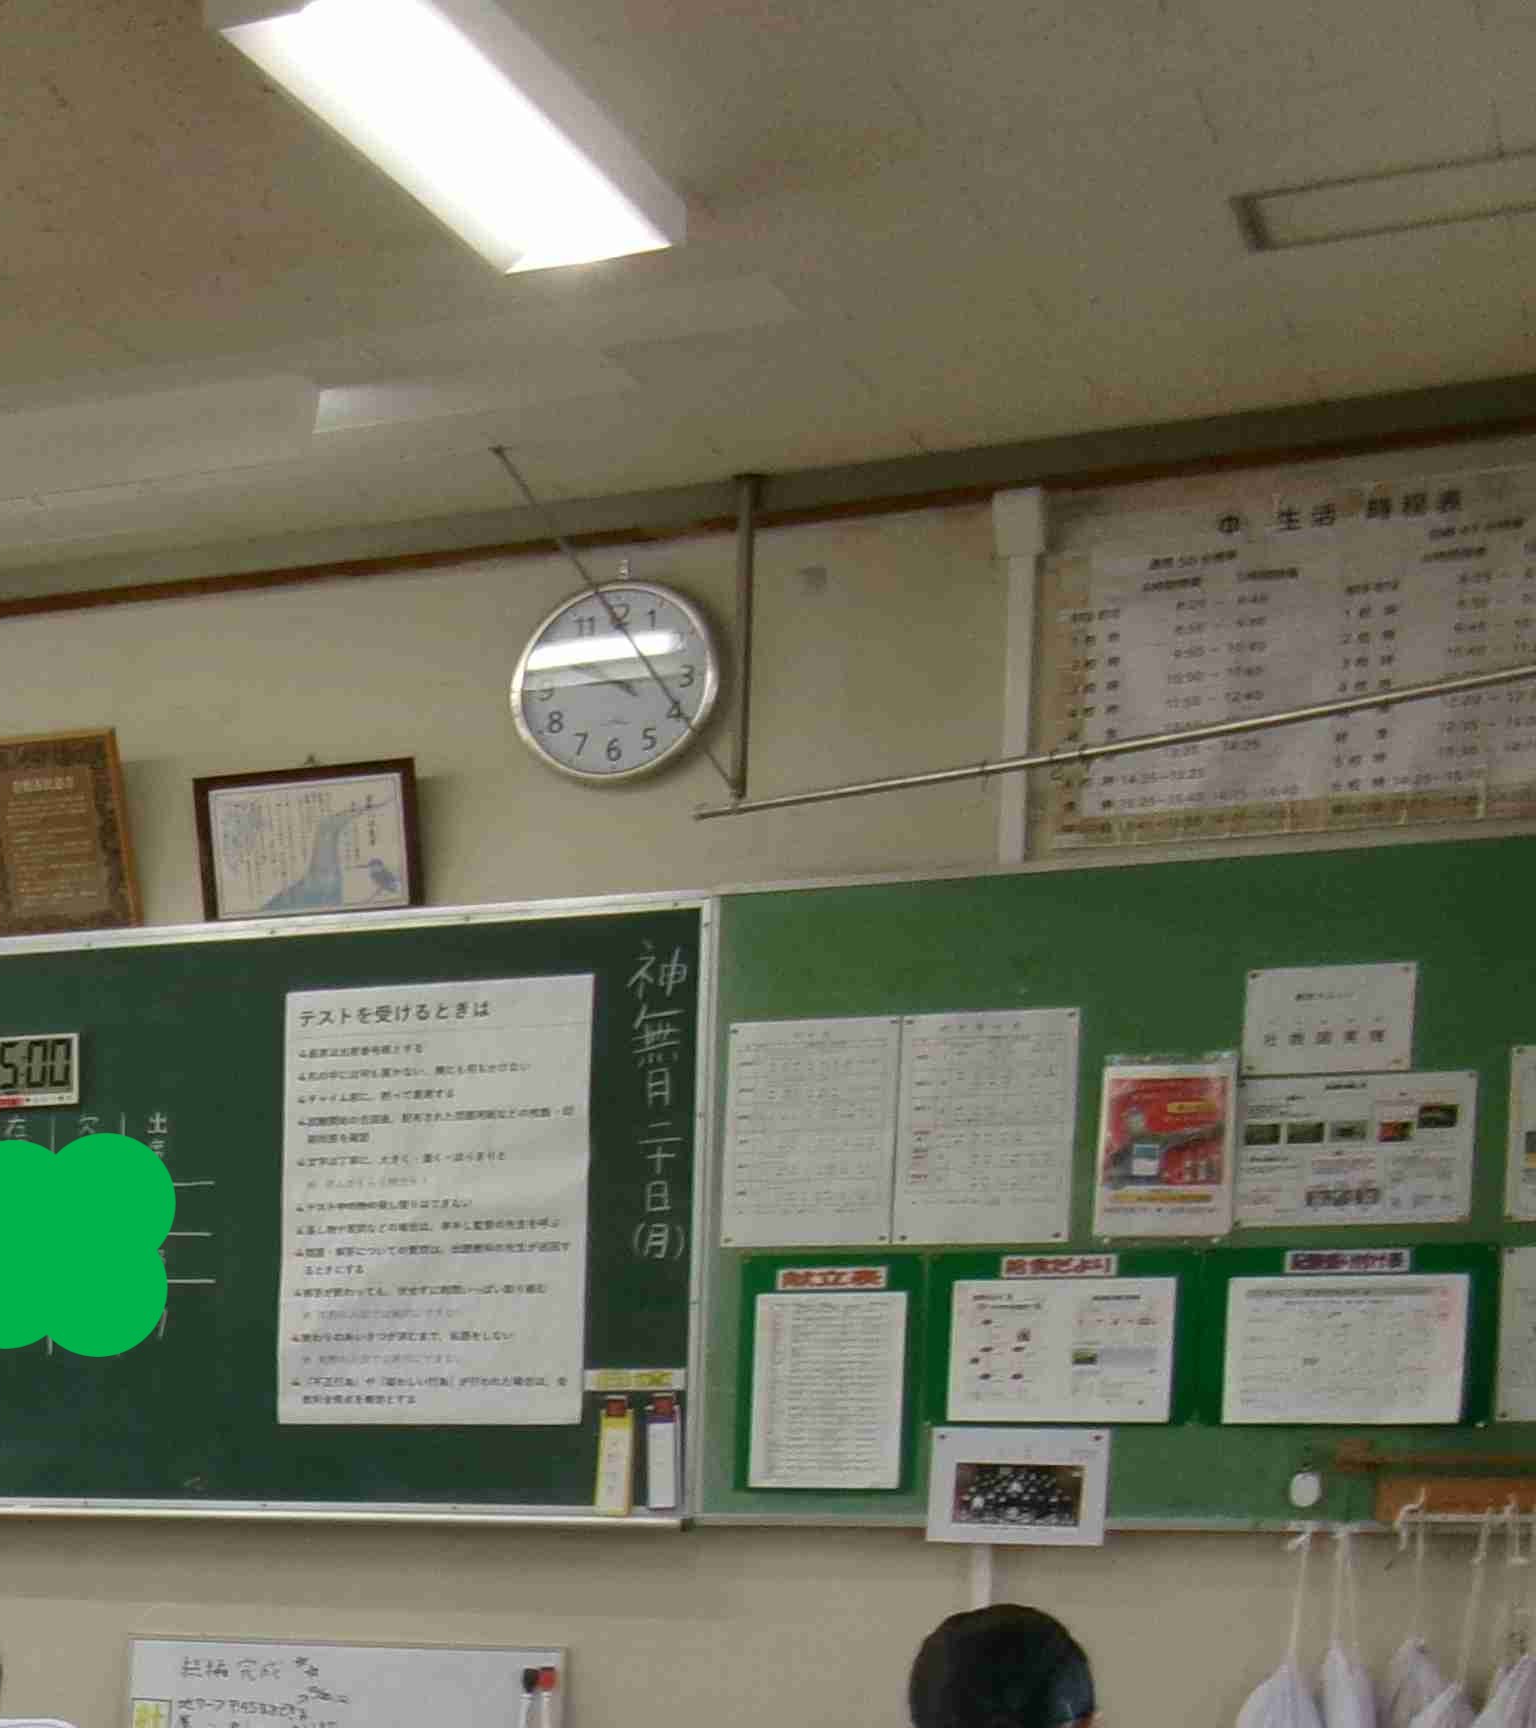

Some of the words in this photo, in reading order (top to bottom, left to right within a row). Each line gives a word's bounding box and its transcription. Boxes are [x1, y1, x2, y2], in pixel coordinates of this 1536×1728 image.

[574, 615, 596, 637] 11
[647, 609, 657, 629] 1
[679, 664, 695, 688] 3
[547, 709, 564, 734] 8
[574, 732, 589, 756] 7
[606, 737, 622, 762] 6
[642, 727, 657, 751] 5
[299, 1000, 491, 1028] テストを受けるときは
